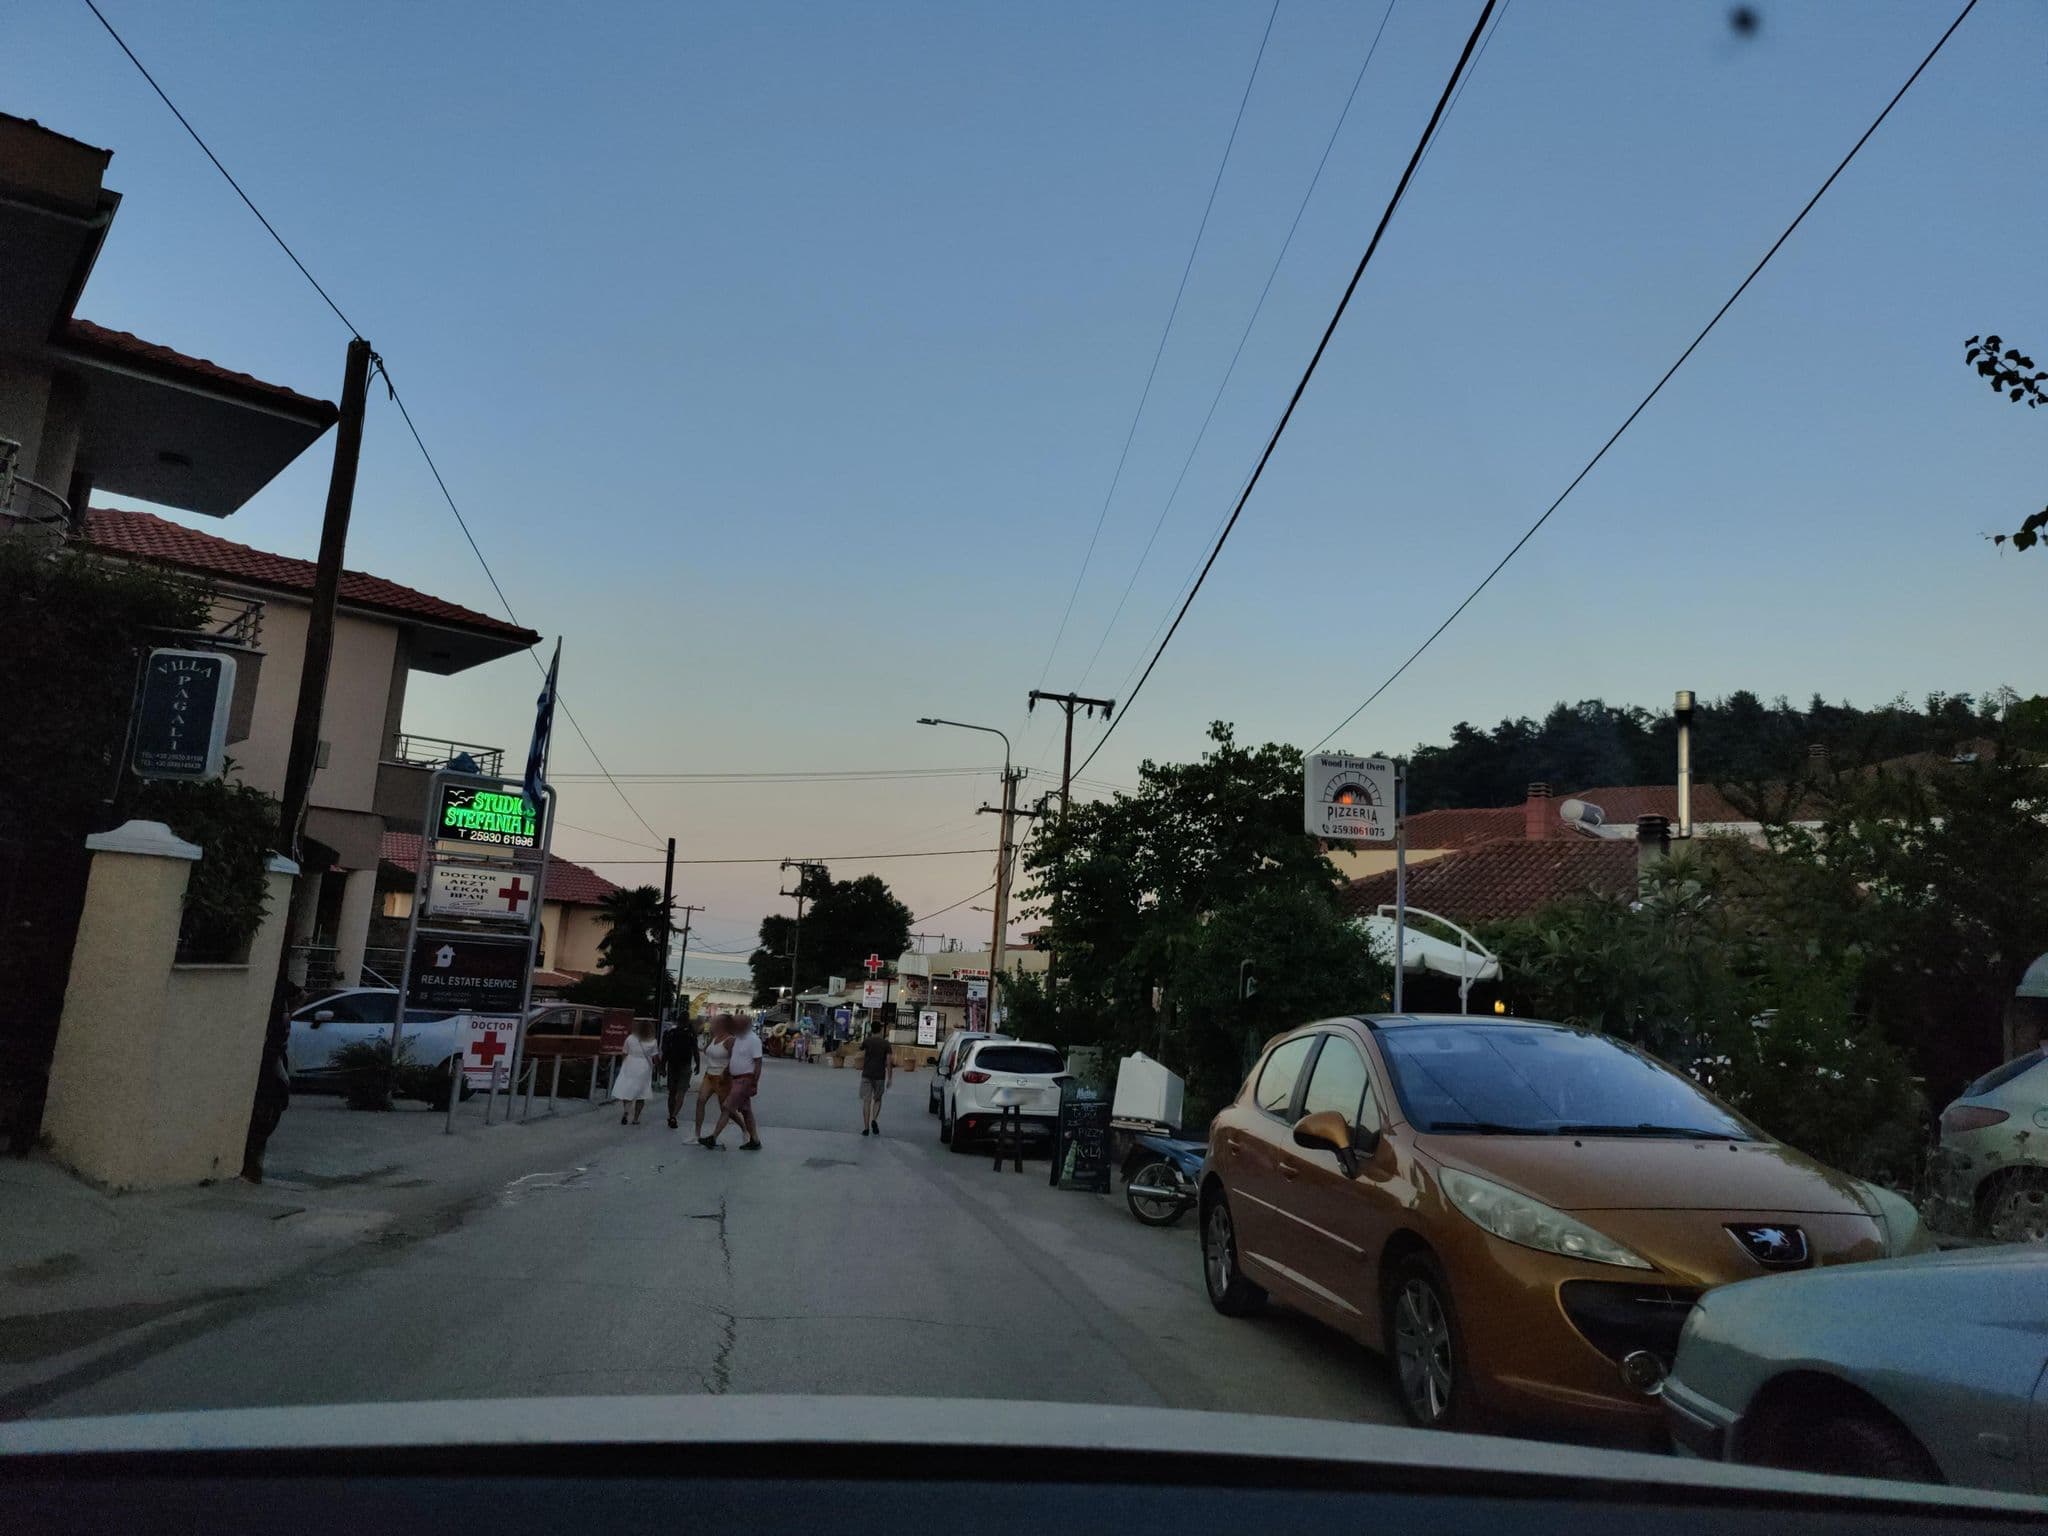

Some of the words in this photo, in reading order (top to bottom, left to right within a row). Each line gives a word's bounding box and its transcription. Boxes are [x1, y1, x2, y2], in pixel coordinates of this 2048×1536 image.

[158, 660, 212, 678] VILLA
[170, 675, 192, 751] PAGALI
[1321, 759, 1342, 768] Wood
[1345, 759, 1364, 769] Fired
[1366, 761, 1385, 771] Oven
[445, 807, 522, 834] STEFANIA
[1327, 806, 1378, 824] PIZZERIA
[458, 829, 467, 838] T
[470, 830, 501, 843] 25930
[440, 871, 497, 881] DOCTOR
[450, 879, 486, 887] ARZT
[445, 885, 489, 894] LEKAR
[421, 974, 446, 985] REAL
[448, 976, 481, 987] ESTATE
[482, 978, 518, 989] SERVICE
[471, 1021, 513, 1031] DOCTOR
